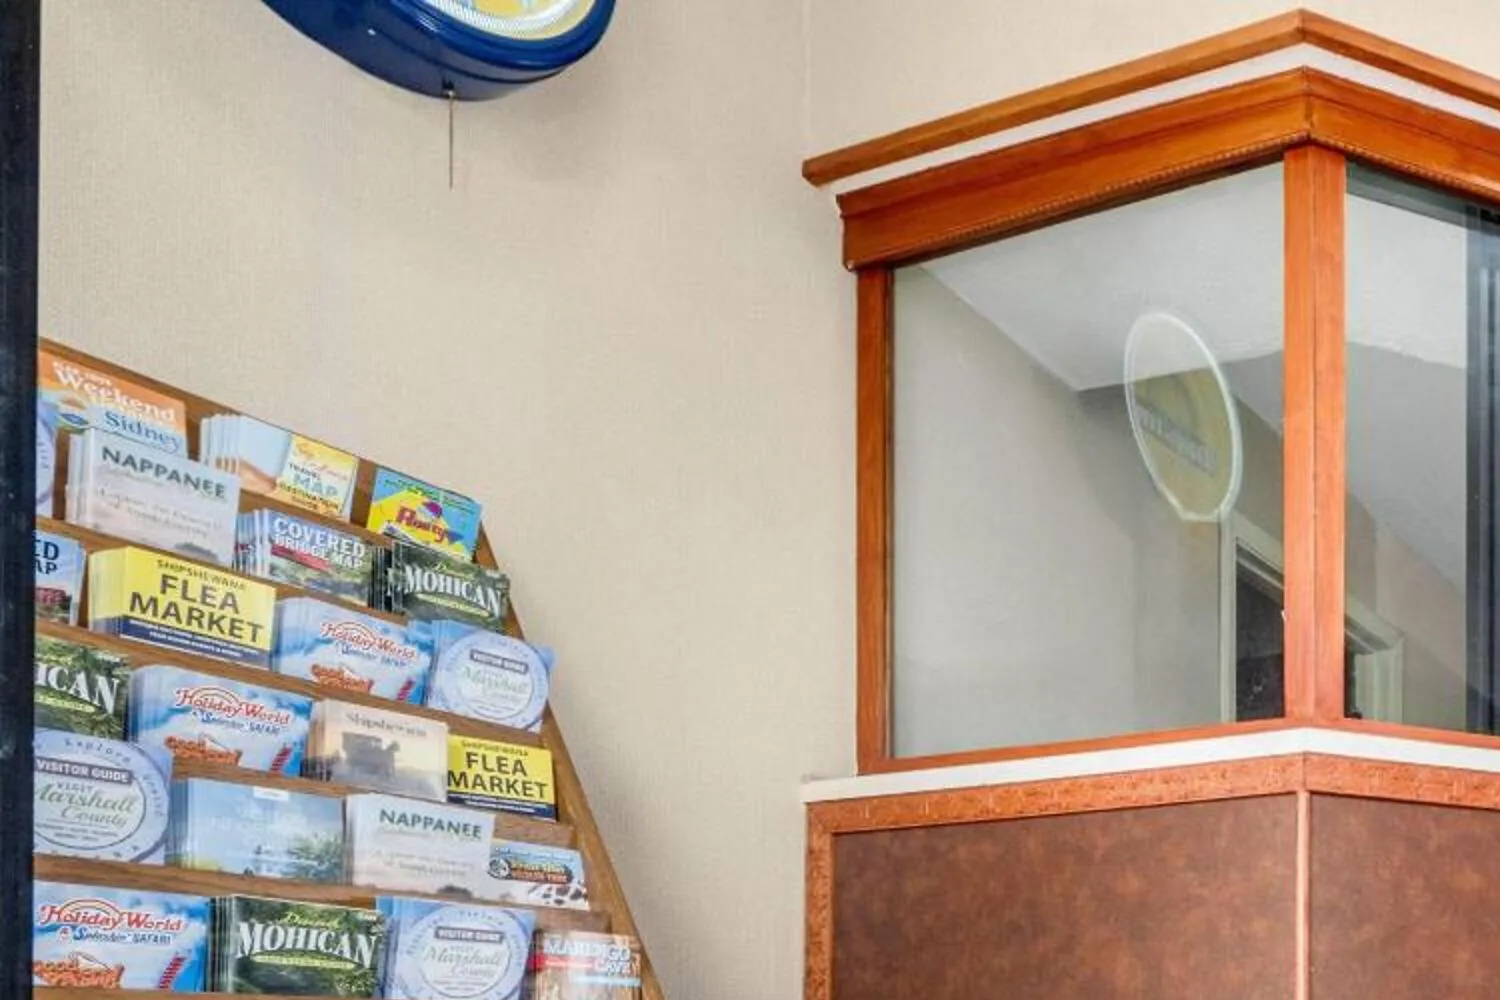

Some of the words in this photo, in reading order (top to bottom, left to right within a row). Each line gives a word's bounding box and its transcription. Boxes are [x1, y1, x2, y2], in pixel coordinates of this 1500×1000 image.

[54, 366, 176, 424] Weekend
[104, 410, 180, 455] Sidney
[102, 446, 226, 500] NAPPANEE
[274, 516, 366, 558] COVERED
[159, 573, 240, 615] FLEA
[403, 563, 502, 620] MOHICAN
[129, 590, 265, 644] MARKET
[34, 661, 121, 715] ICAN
[176, 686, 242, 719] Holiday
[243, 701, 291, 725] World
[36, 759, 90, 778] VISITOR
[91, 767, 130, 783] GUIDE
[447, 769, 549, 799] MARKET
[465, 751, 528, 778] FLEA
[379, 808, 483, 840] NAPPANEE
[40, 903, 119, 931] Holiday
[125, 911, 183, 931] World
[235, 921, 379, 969] MOHICAN
